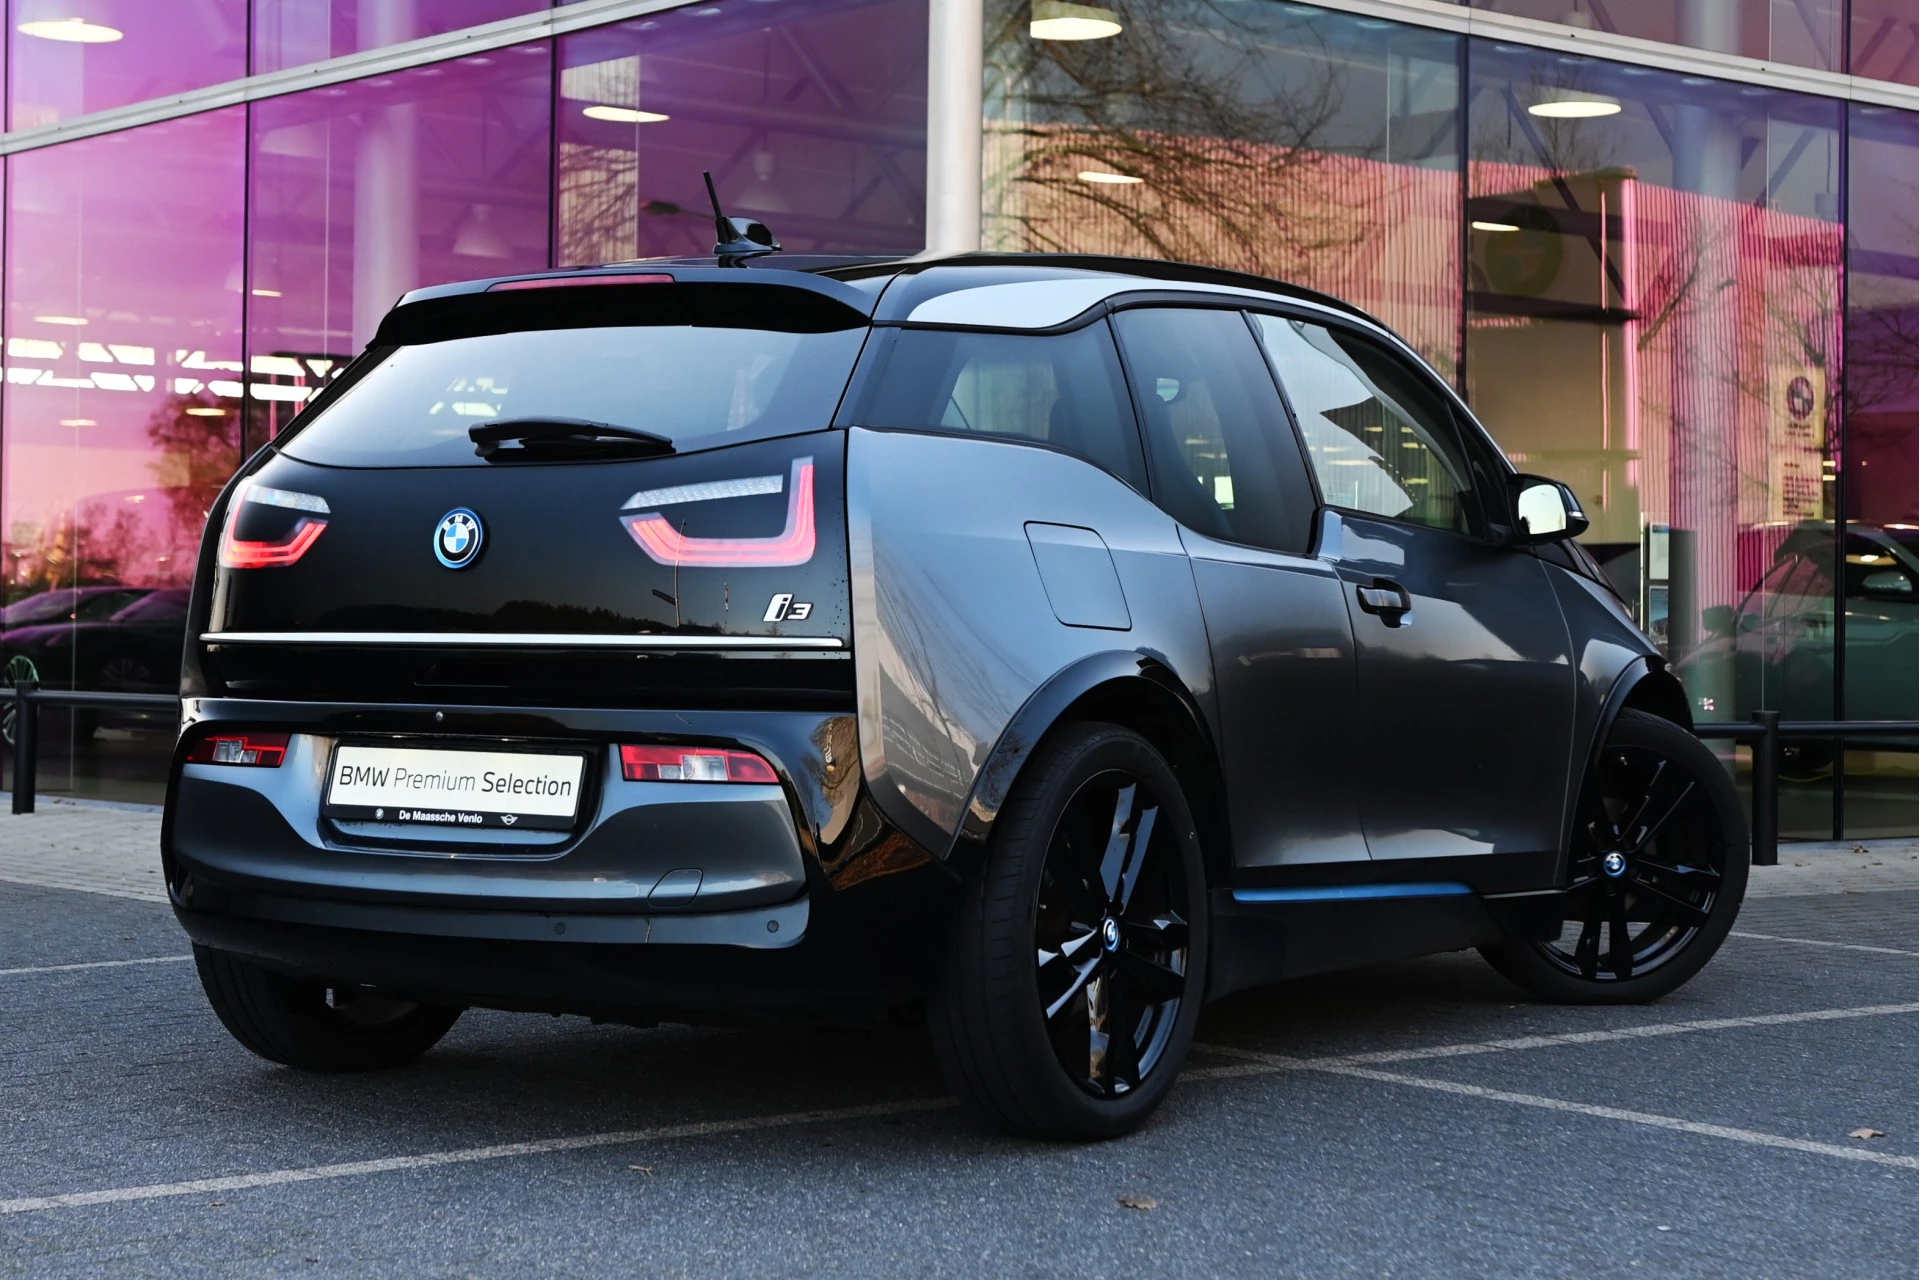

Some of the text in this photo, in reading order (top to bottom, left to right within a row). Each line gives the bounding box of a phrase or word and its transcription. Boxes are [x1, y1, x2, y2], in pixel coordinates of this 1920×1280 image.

[442, 514, 476, 531] BMW
[763, 593, 813, 622] i3
[338, 765, 572, 797] BMW Premium Selection
[398, 809, 483, 824] De Maassche Venlo
